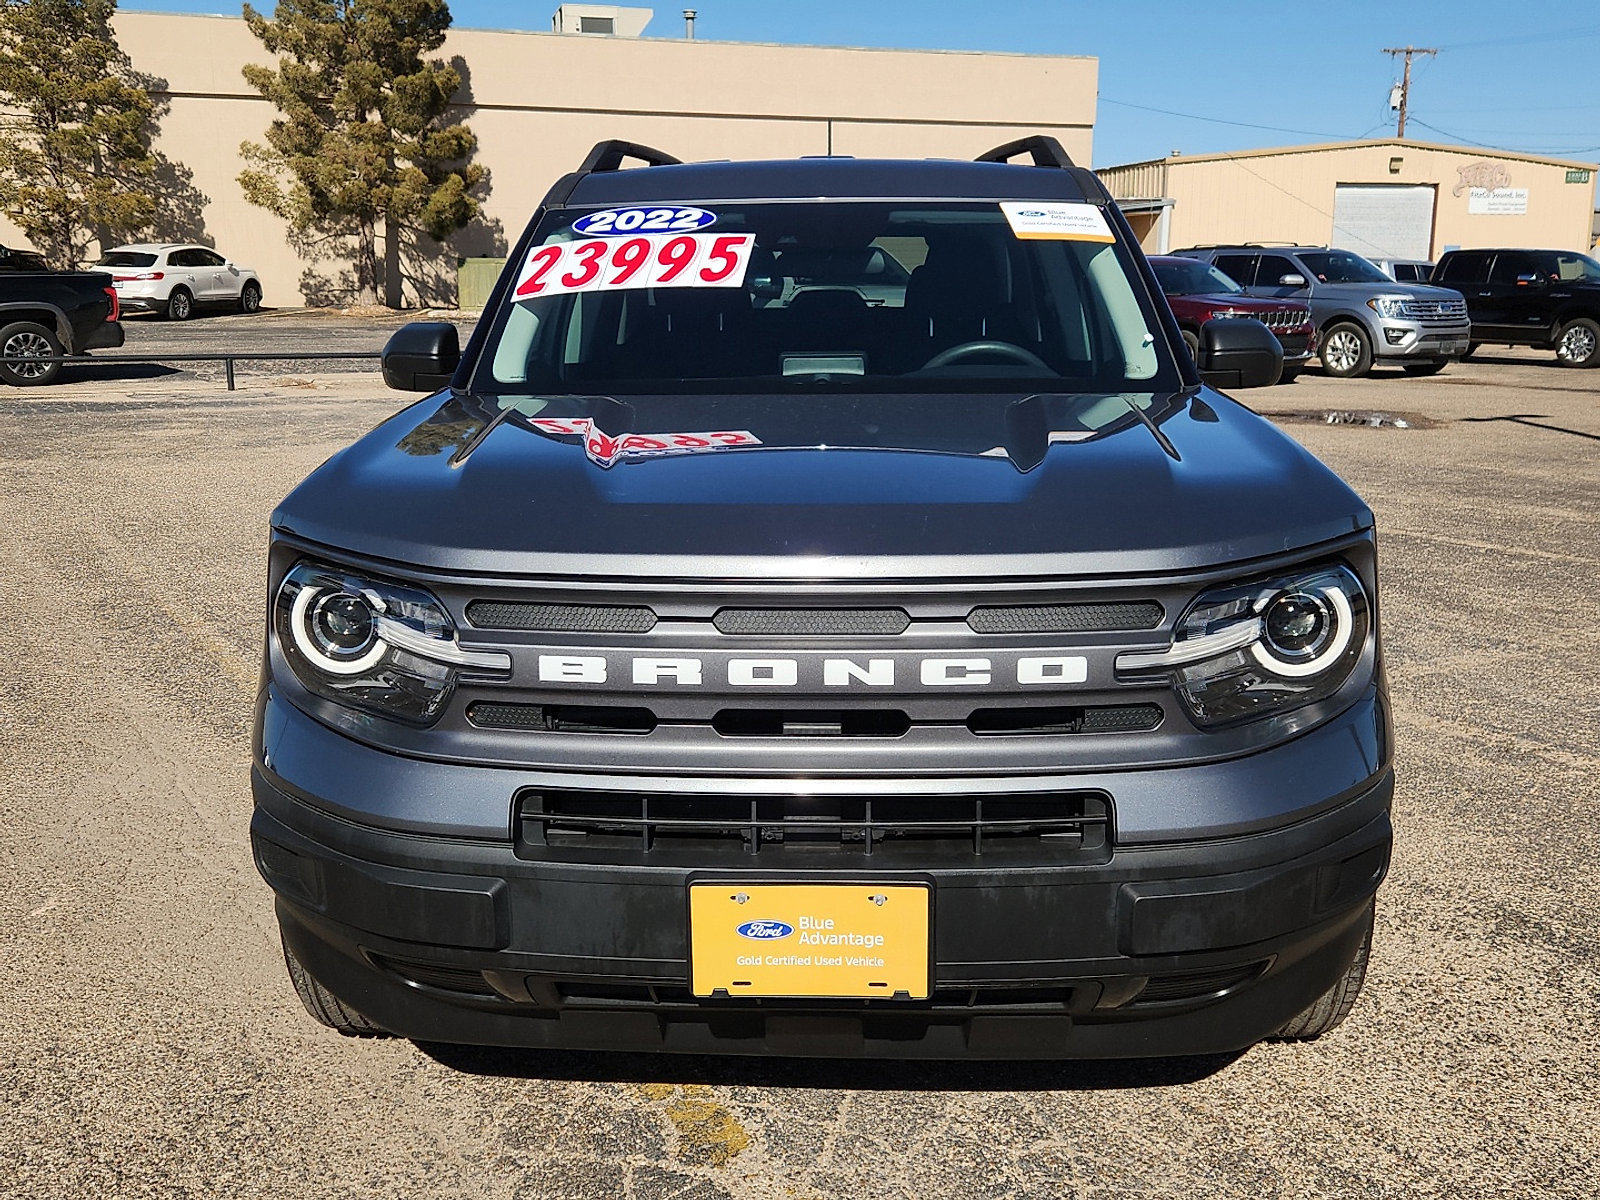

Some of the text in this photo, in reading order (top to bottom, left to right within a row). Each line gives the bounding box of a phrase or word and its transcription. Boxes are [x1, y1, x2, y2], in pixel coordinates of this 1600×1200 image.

[584, 208, 704, 234] 2022
[516, 235, 750, 297] 23995
[538, 655, 1088, 687] BRONCO
[798, 916, 834, 930] Blue
[798, 932, 884, 948] Advantage
[736, 955, 884, 968] Gold Certified Used Vehicle
